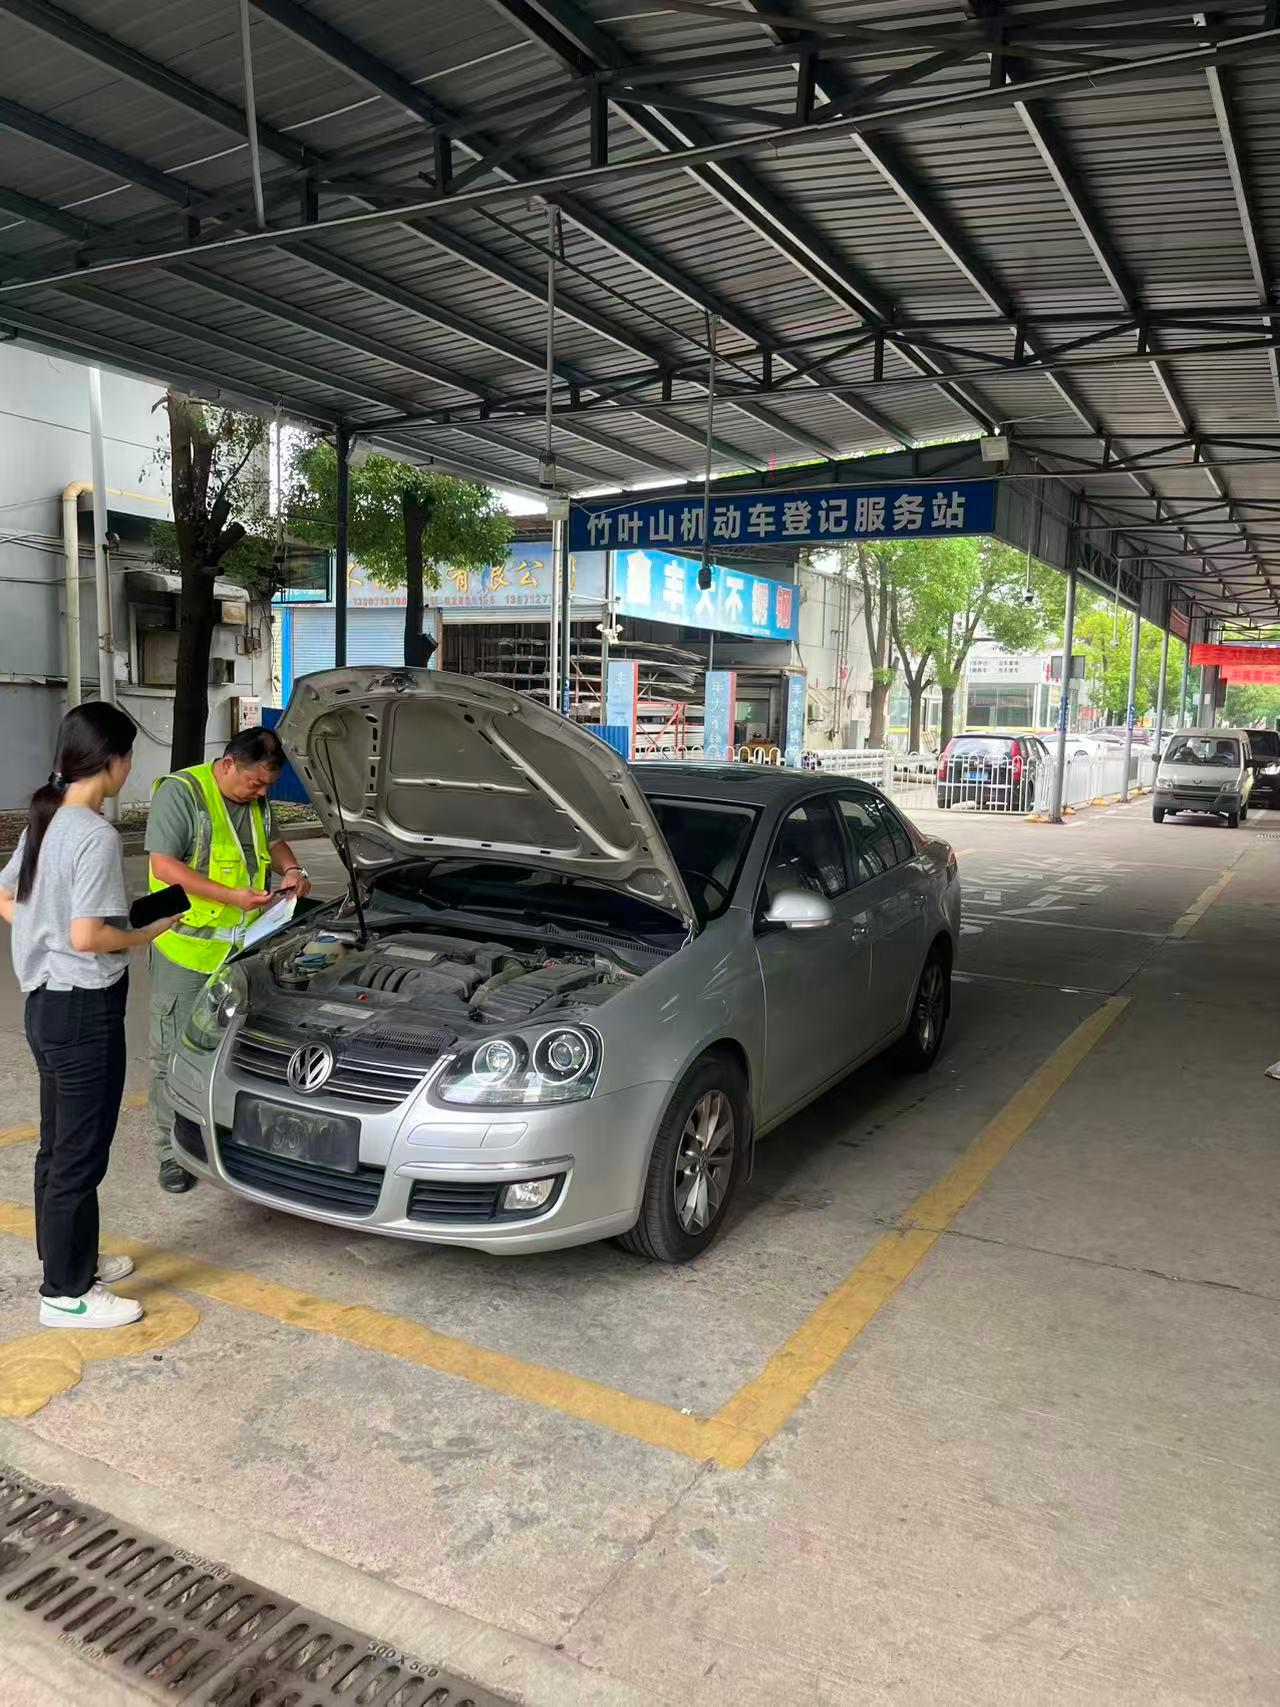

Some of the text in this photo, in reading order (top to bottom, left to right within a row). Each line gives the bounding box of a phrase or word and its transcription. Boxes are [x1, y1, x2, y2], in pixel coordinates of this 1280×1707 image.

[586, 490, 967, 546] 竹叶山机动车登记服务站
[409, 1660, 440, 1678] 500
